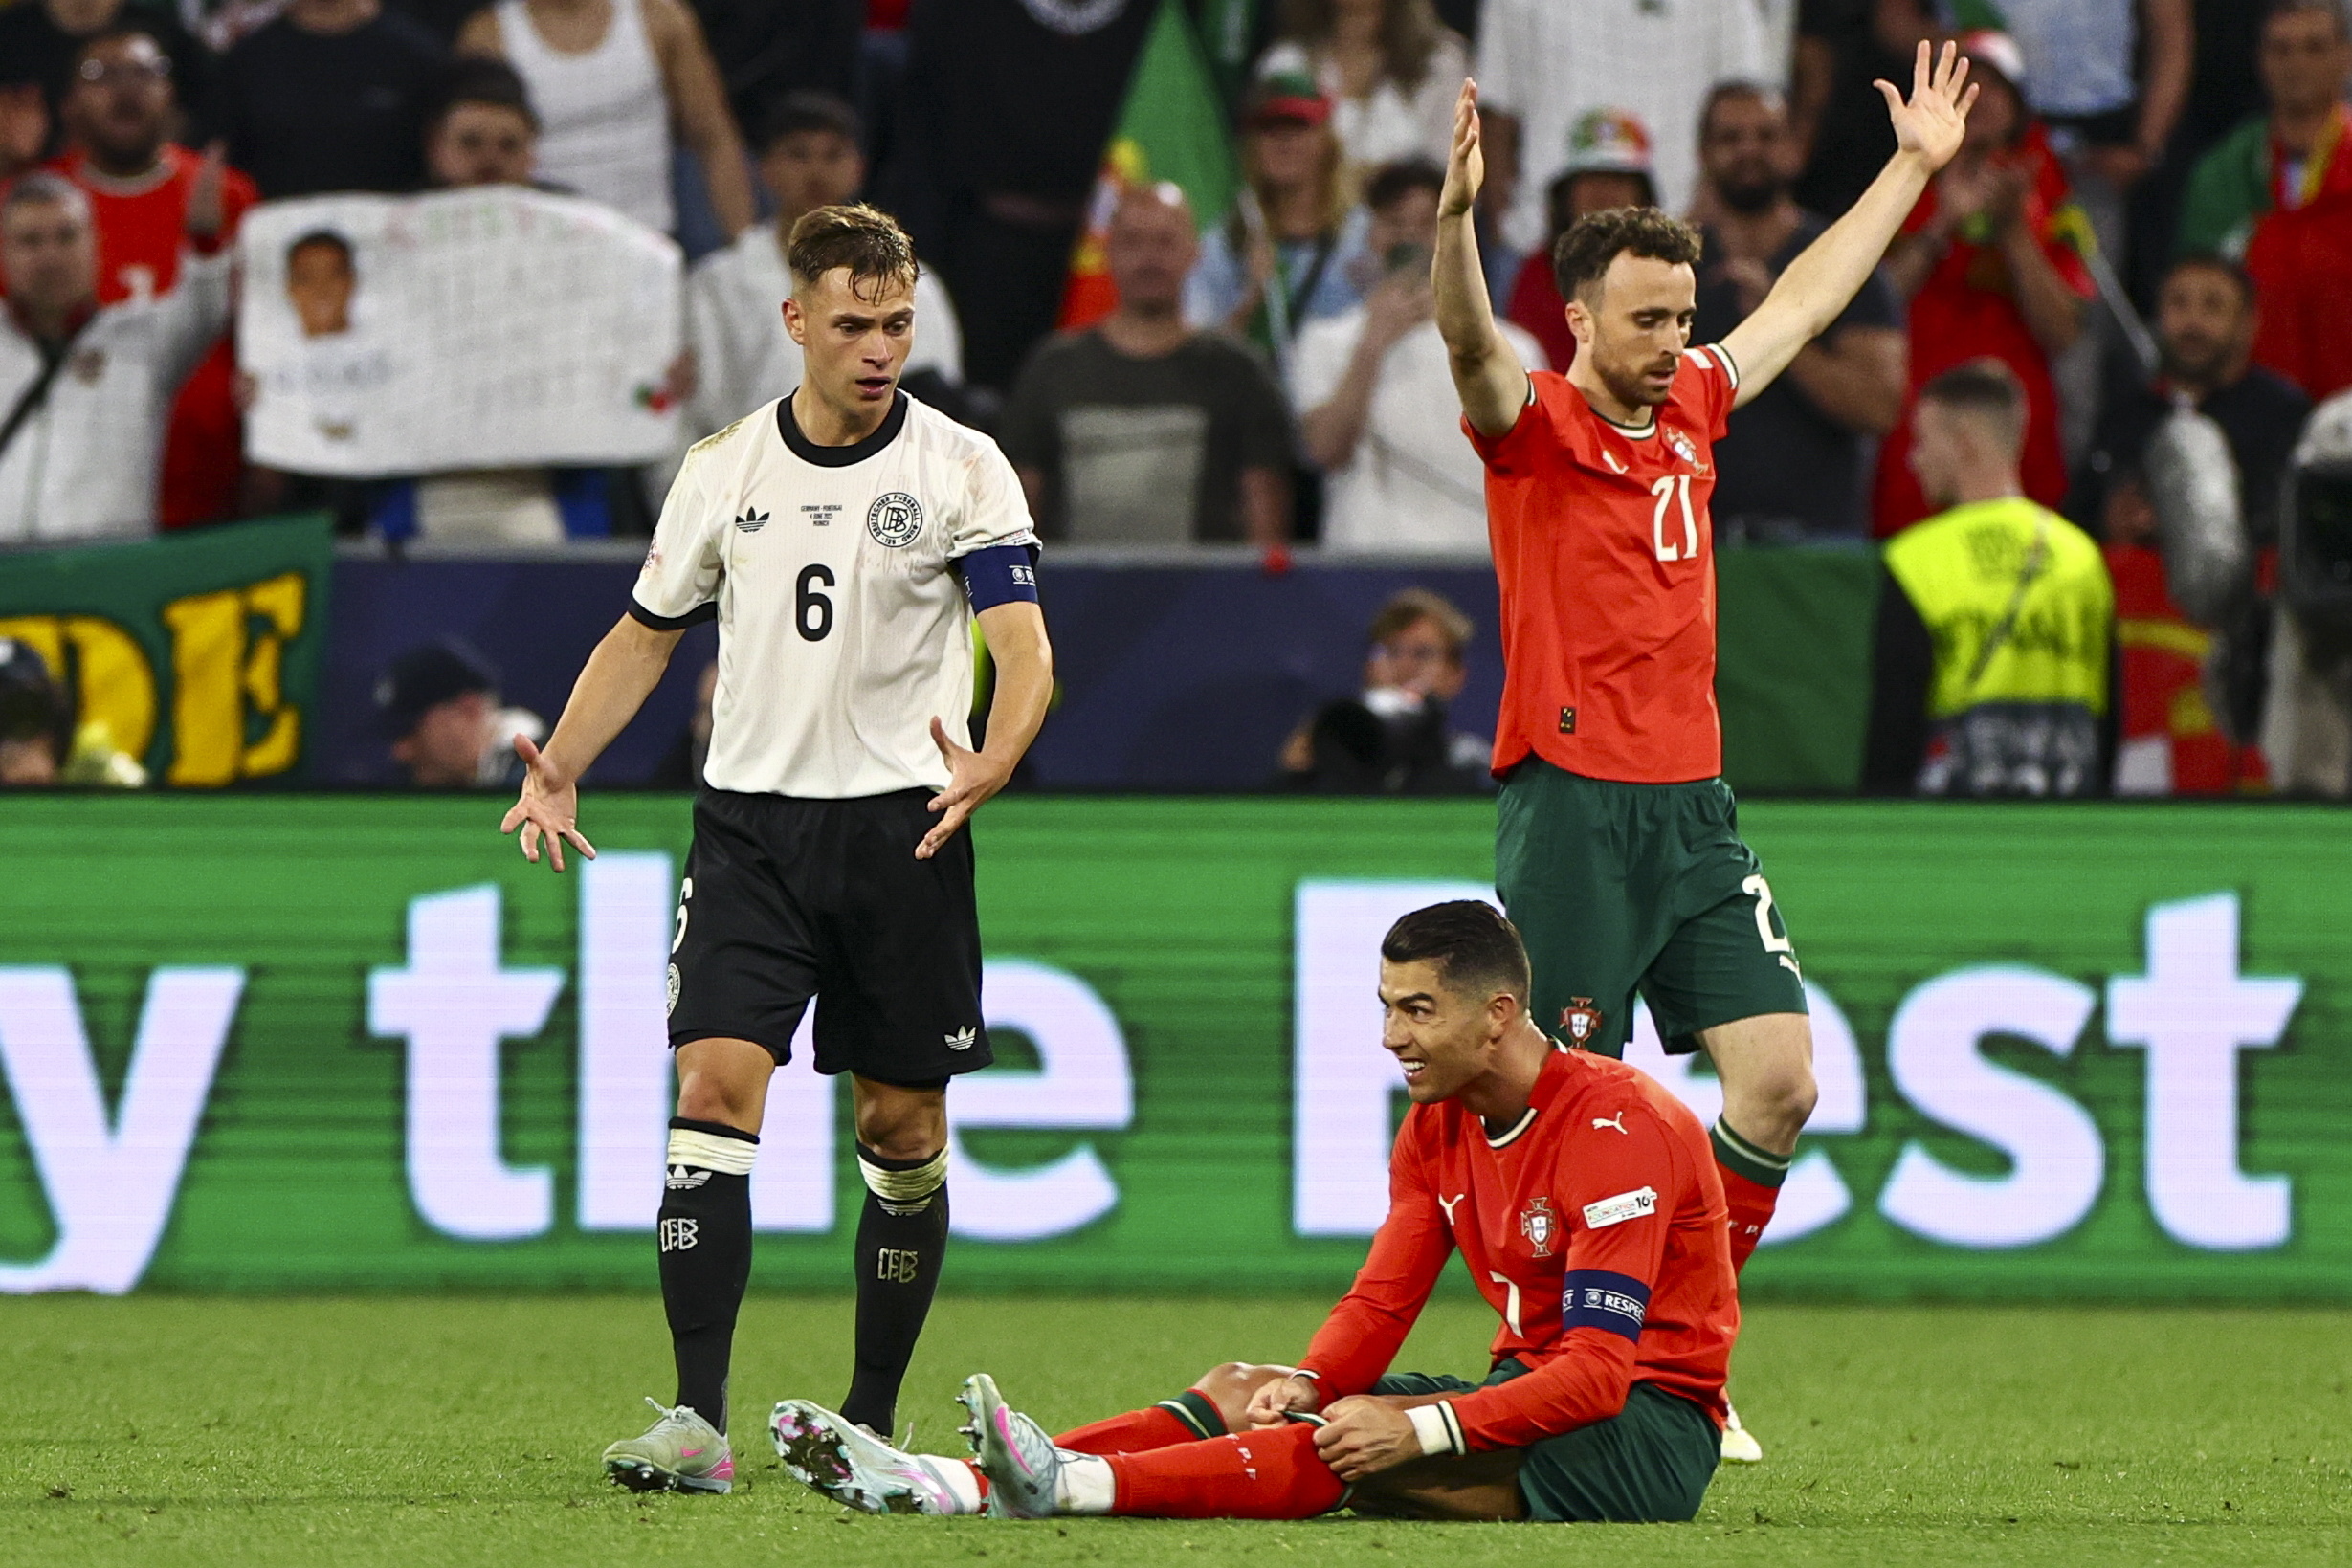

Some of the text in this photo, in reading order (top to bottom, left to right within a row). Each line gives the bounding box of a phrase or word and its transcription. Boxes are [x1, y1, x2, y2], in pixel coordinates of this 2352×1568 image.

[1651, 475, 1698, 562] 21
[795, 563, 836, 642] 6
[1742, 874, 1795, 953] 2
[0, 968, 246, 1295] y
[368, 850, 1134, 1243] the
[1489, 1270, 1525, 1339] 7
